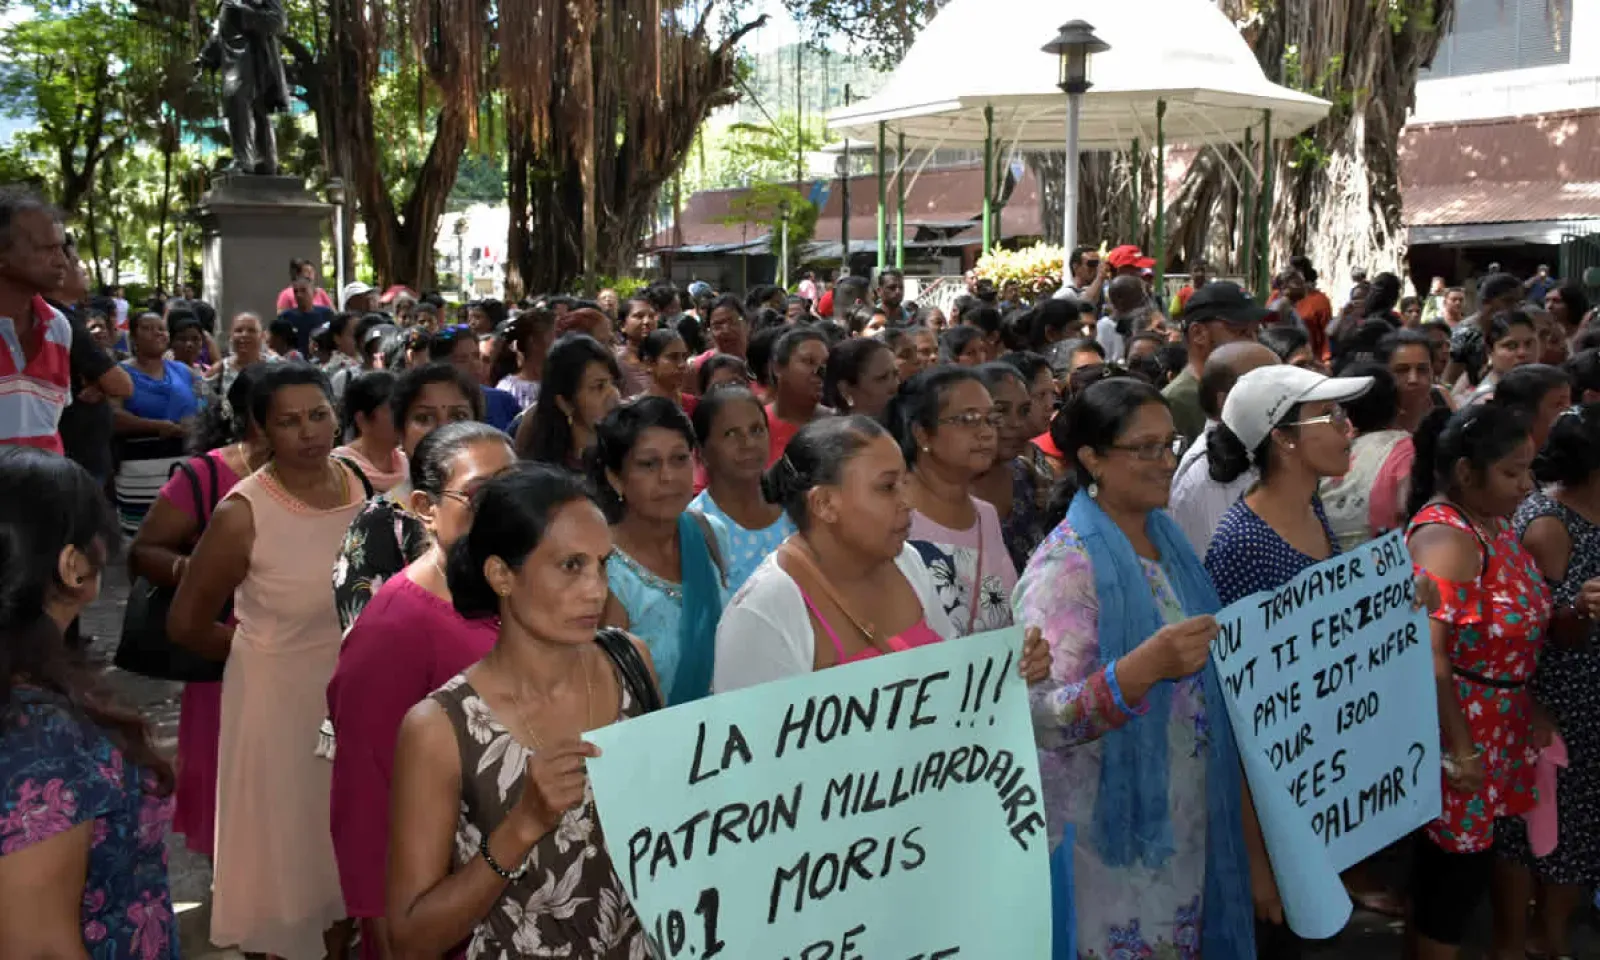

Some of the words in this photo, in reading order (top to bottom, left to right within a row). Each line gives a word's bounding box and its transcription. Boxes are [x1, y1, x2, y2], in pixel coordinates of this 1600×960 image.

[1258, 556, 1365, 631] TRAVAYER
[1271, 635, 1300, 672] TI
[688, 721, 752, 784] LA
[775, 671, 949, 757] HONTE
[1253, 681, 1300, 736] PAYE
[1337, 691, 1379, 735] 1300
[629, 781, 802, 899] PATRON
[821, 744, 1045, 851] MILLIARDAIRE
[767, 826, 926, 924] MORIS
